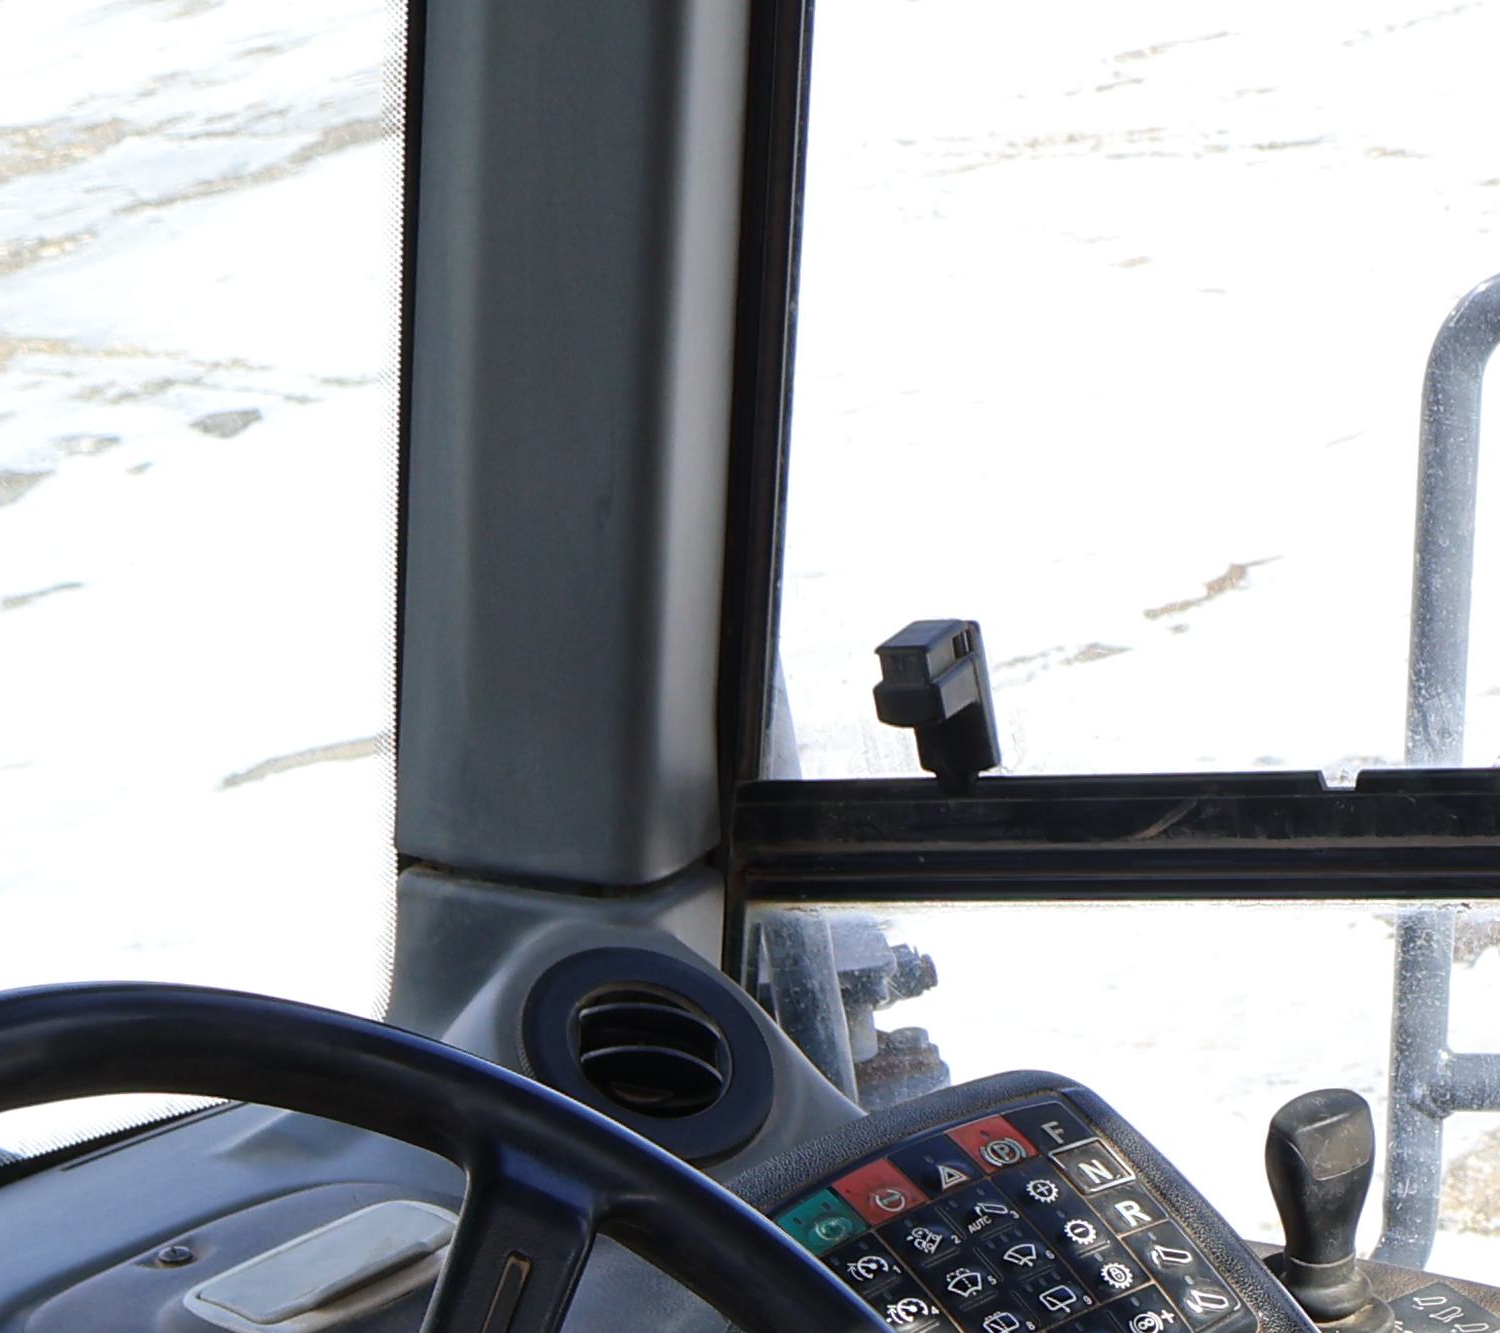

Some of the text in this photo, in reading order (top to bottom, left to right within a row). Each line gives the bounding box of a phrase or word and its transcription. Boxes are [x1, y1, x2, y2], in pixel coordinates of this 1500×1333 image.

[1041, 1121, 1065, 1144] F
[1078, 1159, 1113, 1184] N
[1010, 1210, 1020, 1219] 3
[1114, 1201, 1152, 1227] R
[951, 1235, 961, 1244] 2
[1045, 1250, 1055, 1259] 6
[892, 1265, 902, 1274] 1
[987, 1275, 998, 1285] 5
[1082, 1295, 1093, 1305] 9
[931, 1306, 940, 1315] 4
[1025, 1321, 1036, 1331] 8
